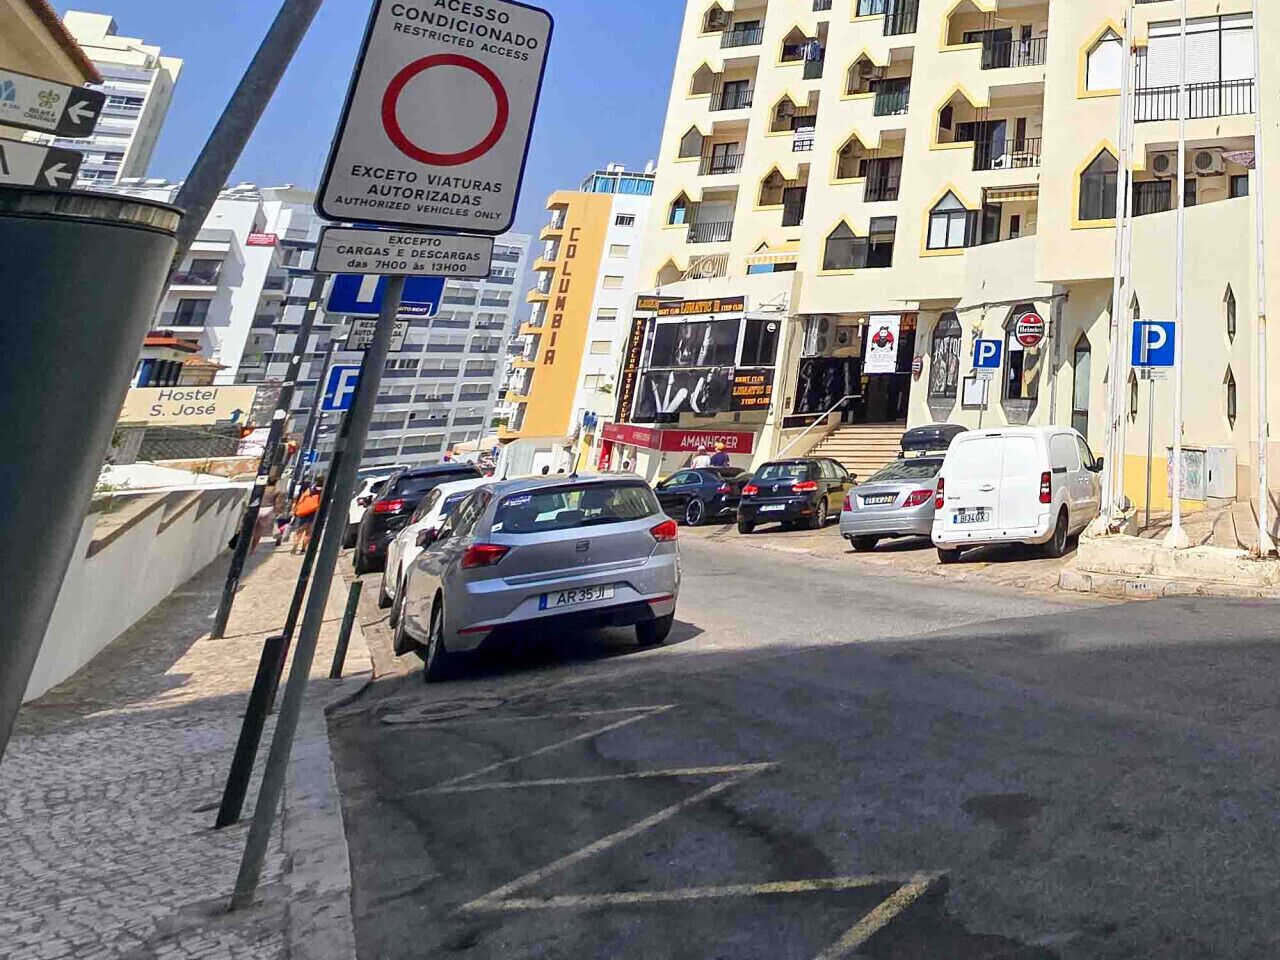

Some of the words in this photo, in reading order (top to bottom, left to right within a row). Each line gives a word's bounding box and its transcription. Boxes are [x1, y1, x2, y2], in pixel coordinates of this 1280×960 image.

[391, 3, 538, 50] CONDICIONADO
[393, 22, 475, 48] RESTRICTED
[480, 43, 530, 61] ACCESS
[351, 164, 418, 183] EXCETO
[427, 173, 503, 193] VIATURAS
[366, 183, 483, 207] AUTORIZADAS
[334, 195, 411, 211] AUTHORIZED
[416, 205, 469, 217] VEHICLES
[474, 210, 502, 220] ONLY
[336, 245, 390, 257] CARGAS
[397, 249, 405, 258] E
[411, 249, 481, 261] DESCARGAS
[388, 235, 442, 247] EXCEPTO
[347, 259, 368, 269] das
[374, 260, 408, 271] 7H00
[431, 262, 467, 273] 13H00
[543, 227, 581, 365] COLUMBIA
[979, 341, 996, 366] P
[1140, 324, 1167, 363] P
[157, 388, 219, 401] Hostel
[150, 404, 166, 417] S.
[172, 403, 216, 417] José
[680, 435, 738, 449] AMANHECER
[556, 591, 576, 606] AR
[579, 588, 594, 601] 35
